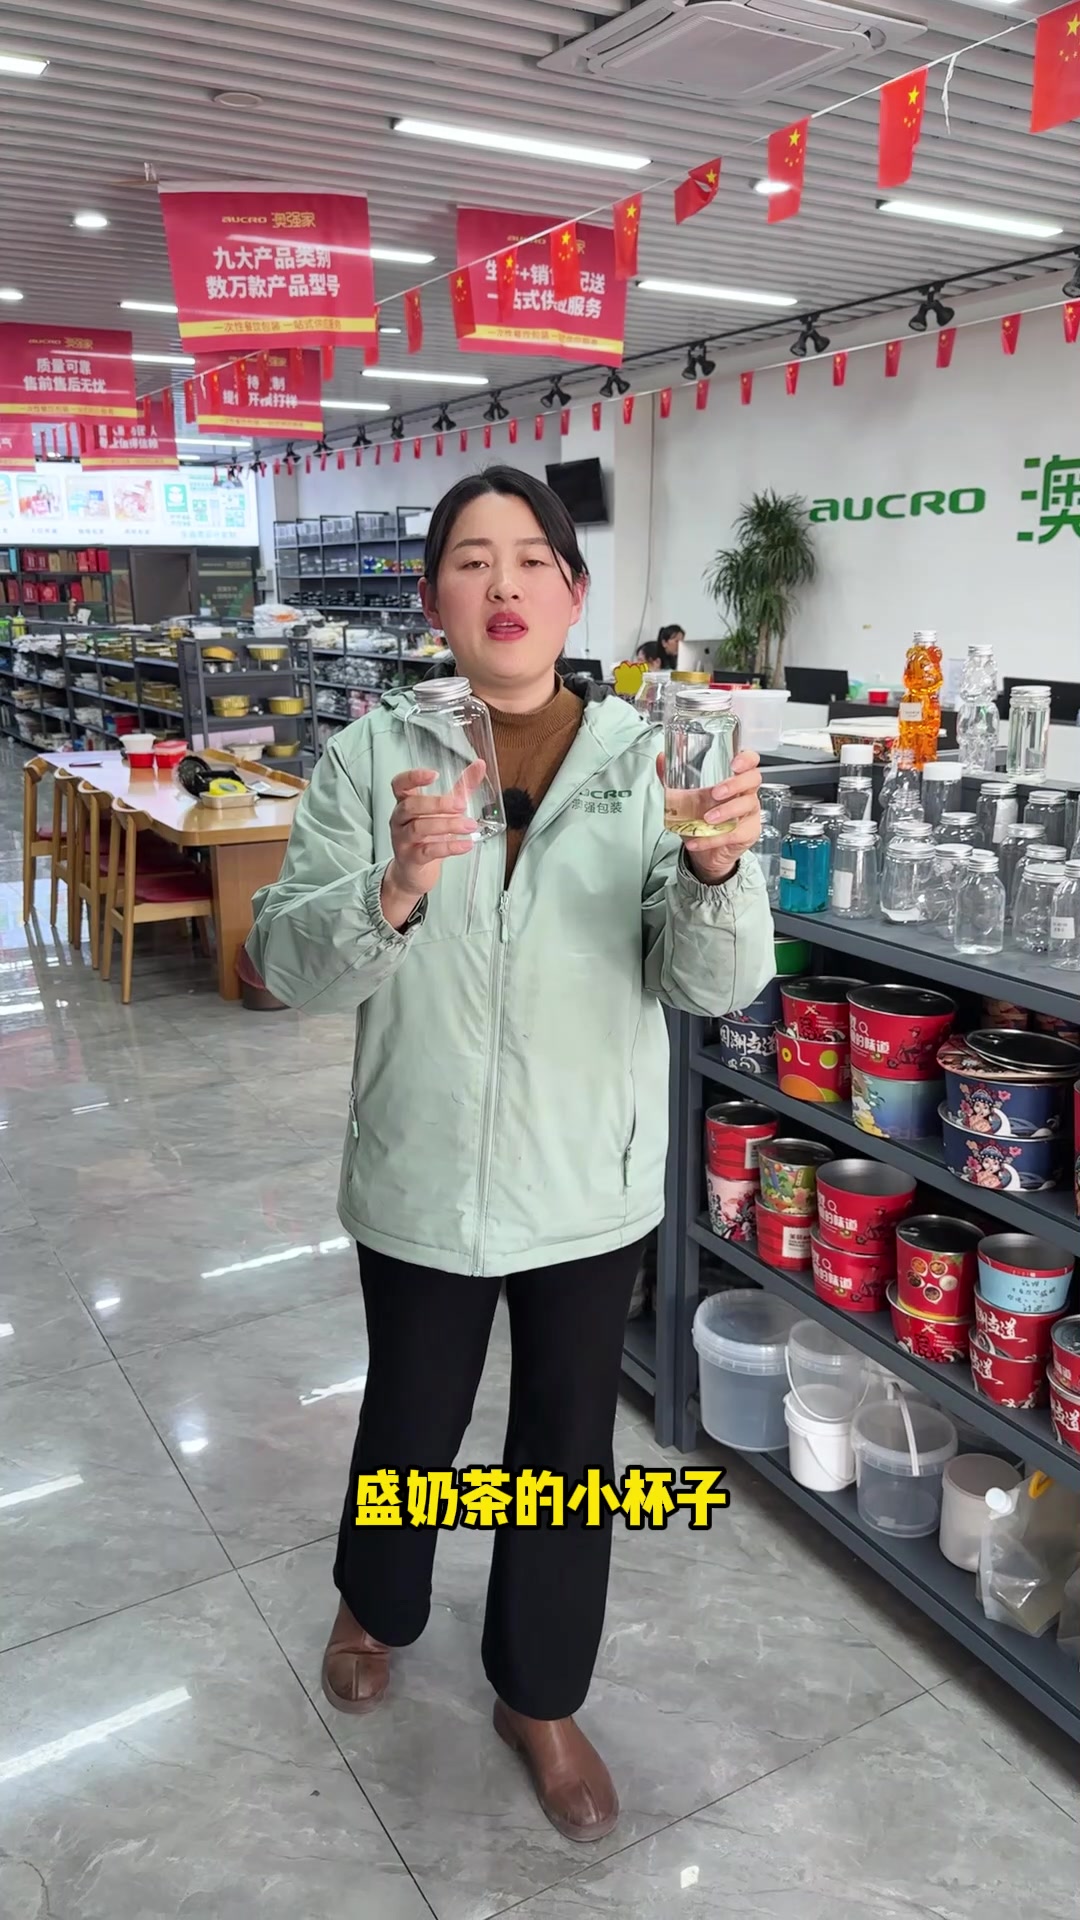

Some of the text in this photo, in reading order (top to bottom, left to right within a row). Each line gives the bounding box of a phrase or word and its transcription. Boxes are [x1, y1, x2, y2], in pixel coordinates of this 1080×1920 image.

[213, 245, 332, 271] 九大产品类别
[205, 273, 341, 300] 数万款产品型号
[36, 357, 92, 376] 质量可靠
[23, 375, 107, 395] 售前售后无忧
